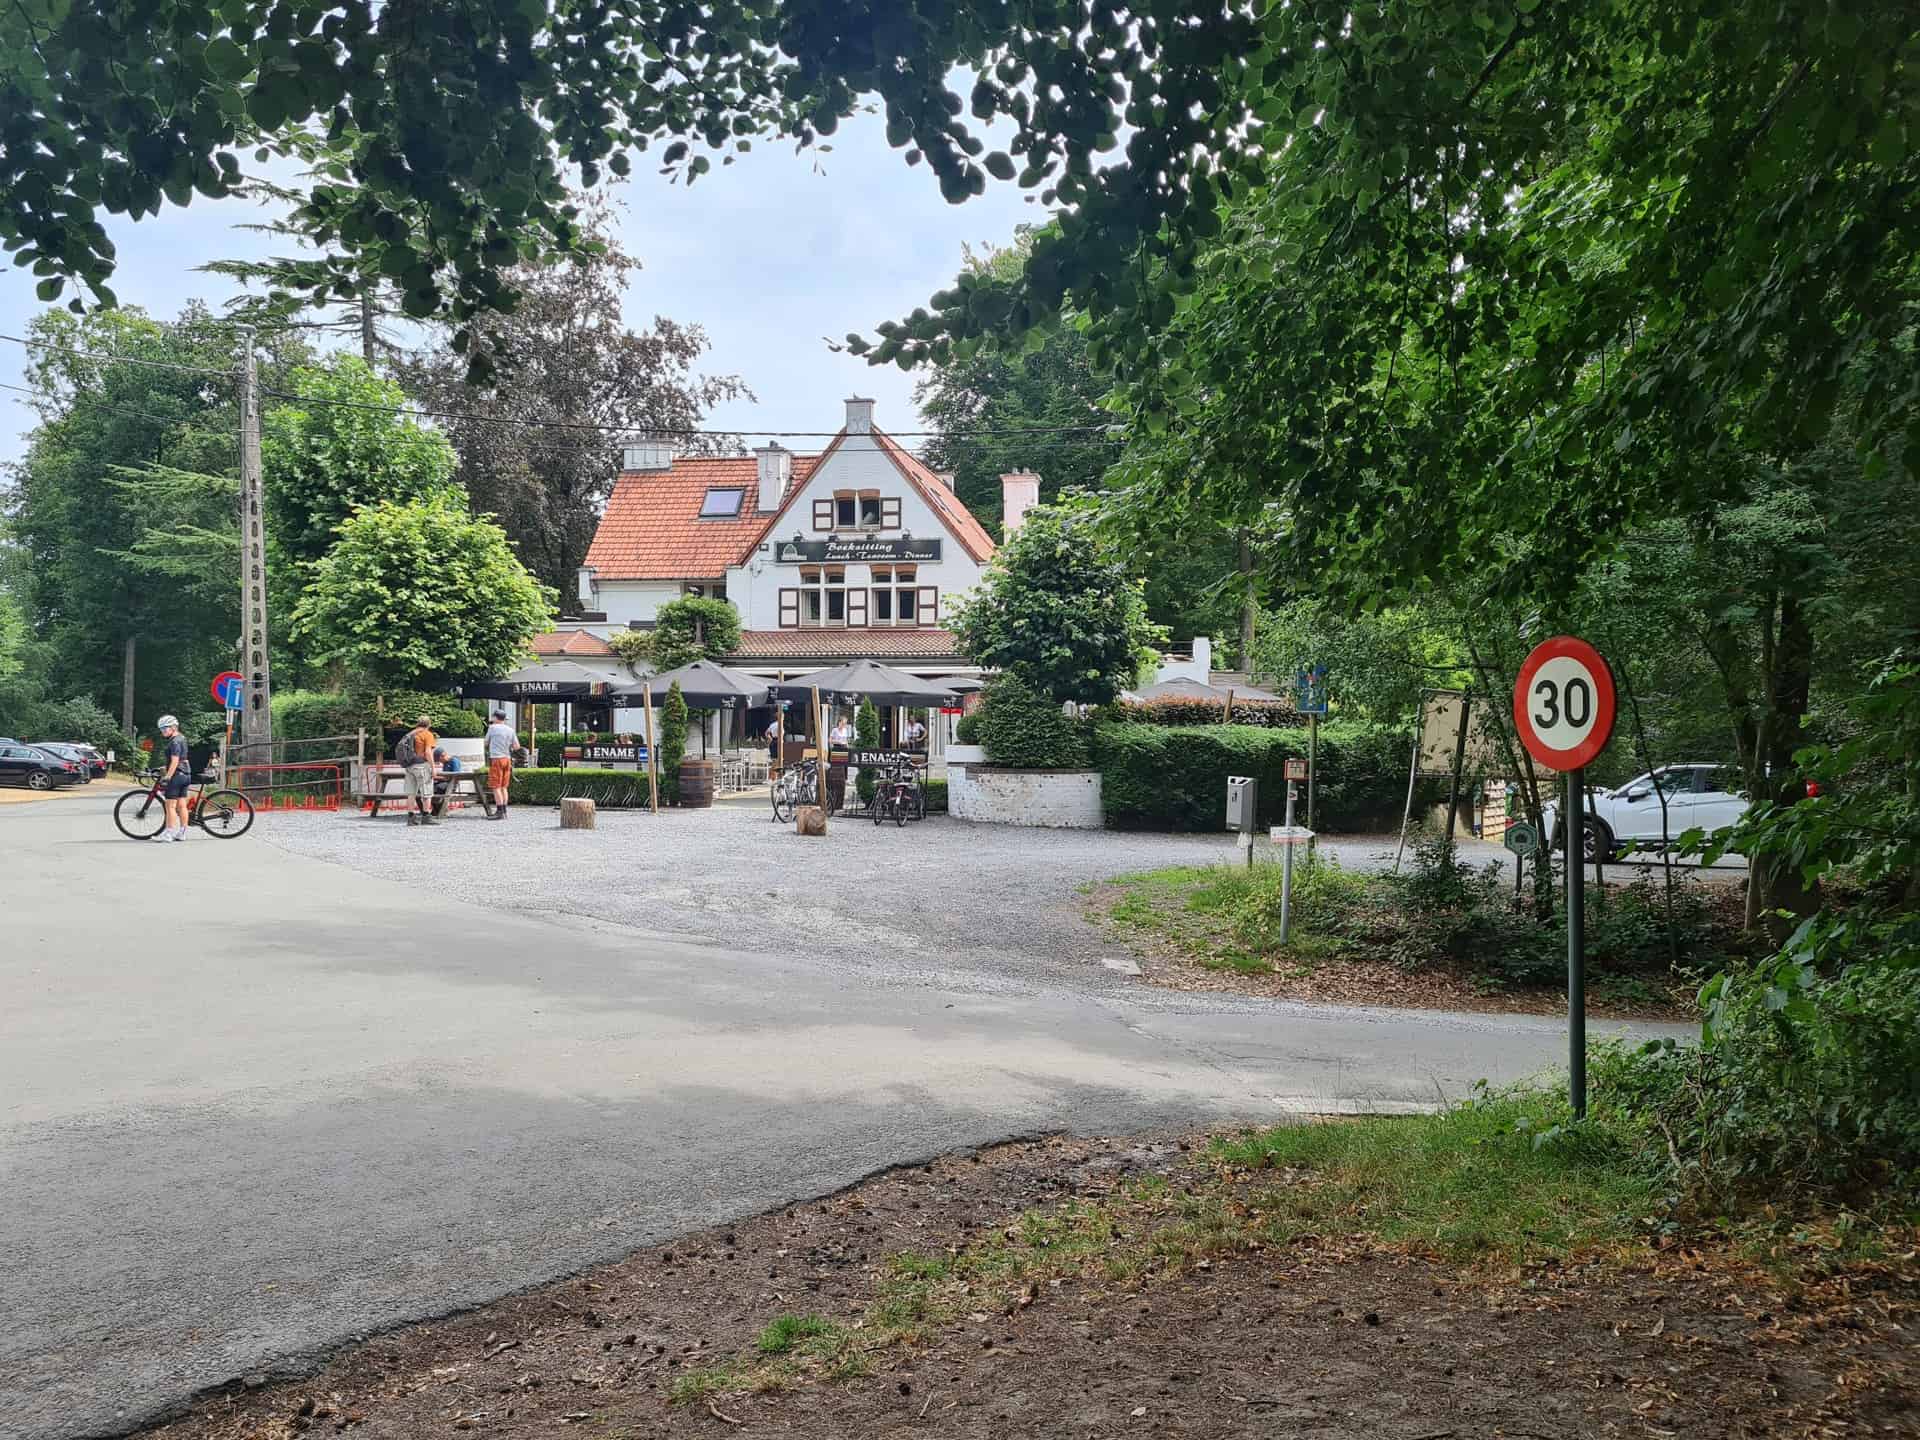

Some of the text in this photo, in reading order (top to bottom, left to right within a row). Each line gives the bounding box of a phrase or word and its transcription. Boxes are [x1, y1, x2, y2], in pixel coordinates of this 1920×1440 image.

[824, 552, 850, 560] Lunch
[903, 551, 933, 559] Dinner
[521, 682, 559, 691] ENAME
[1534, 677, 1590, 729] 30
[593, 747, 635, 757] ENAME
